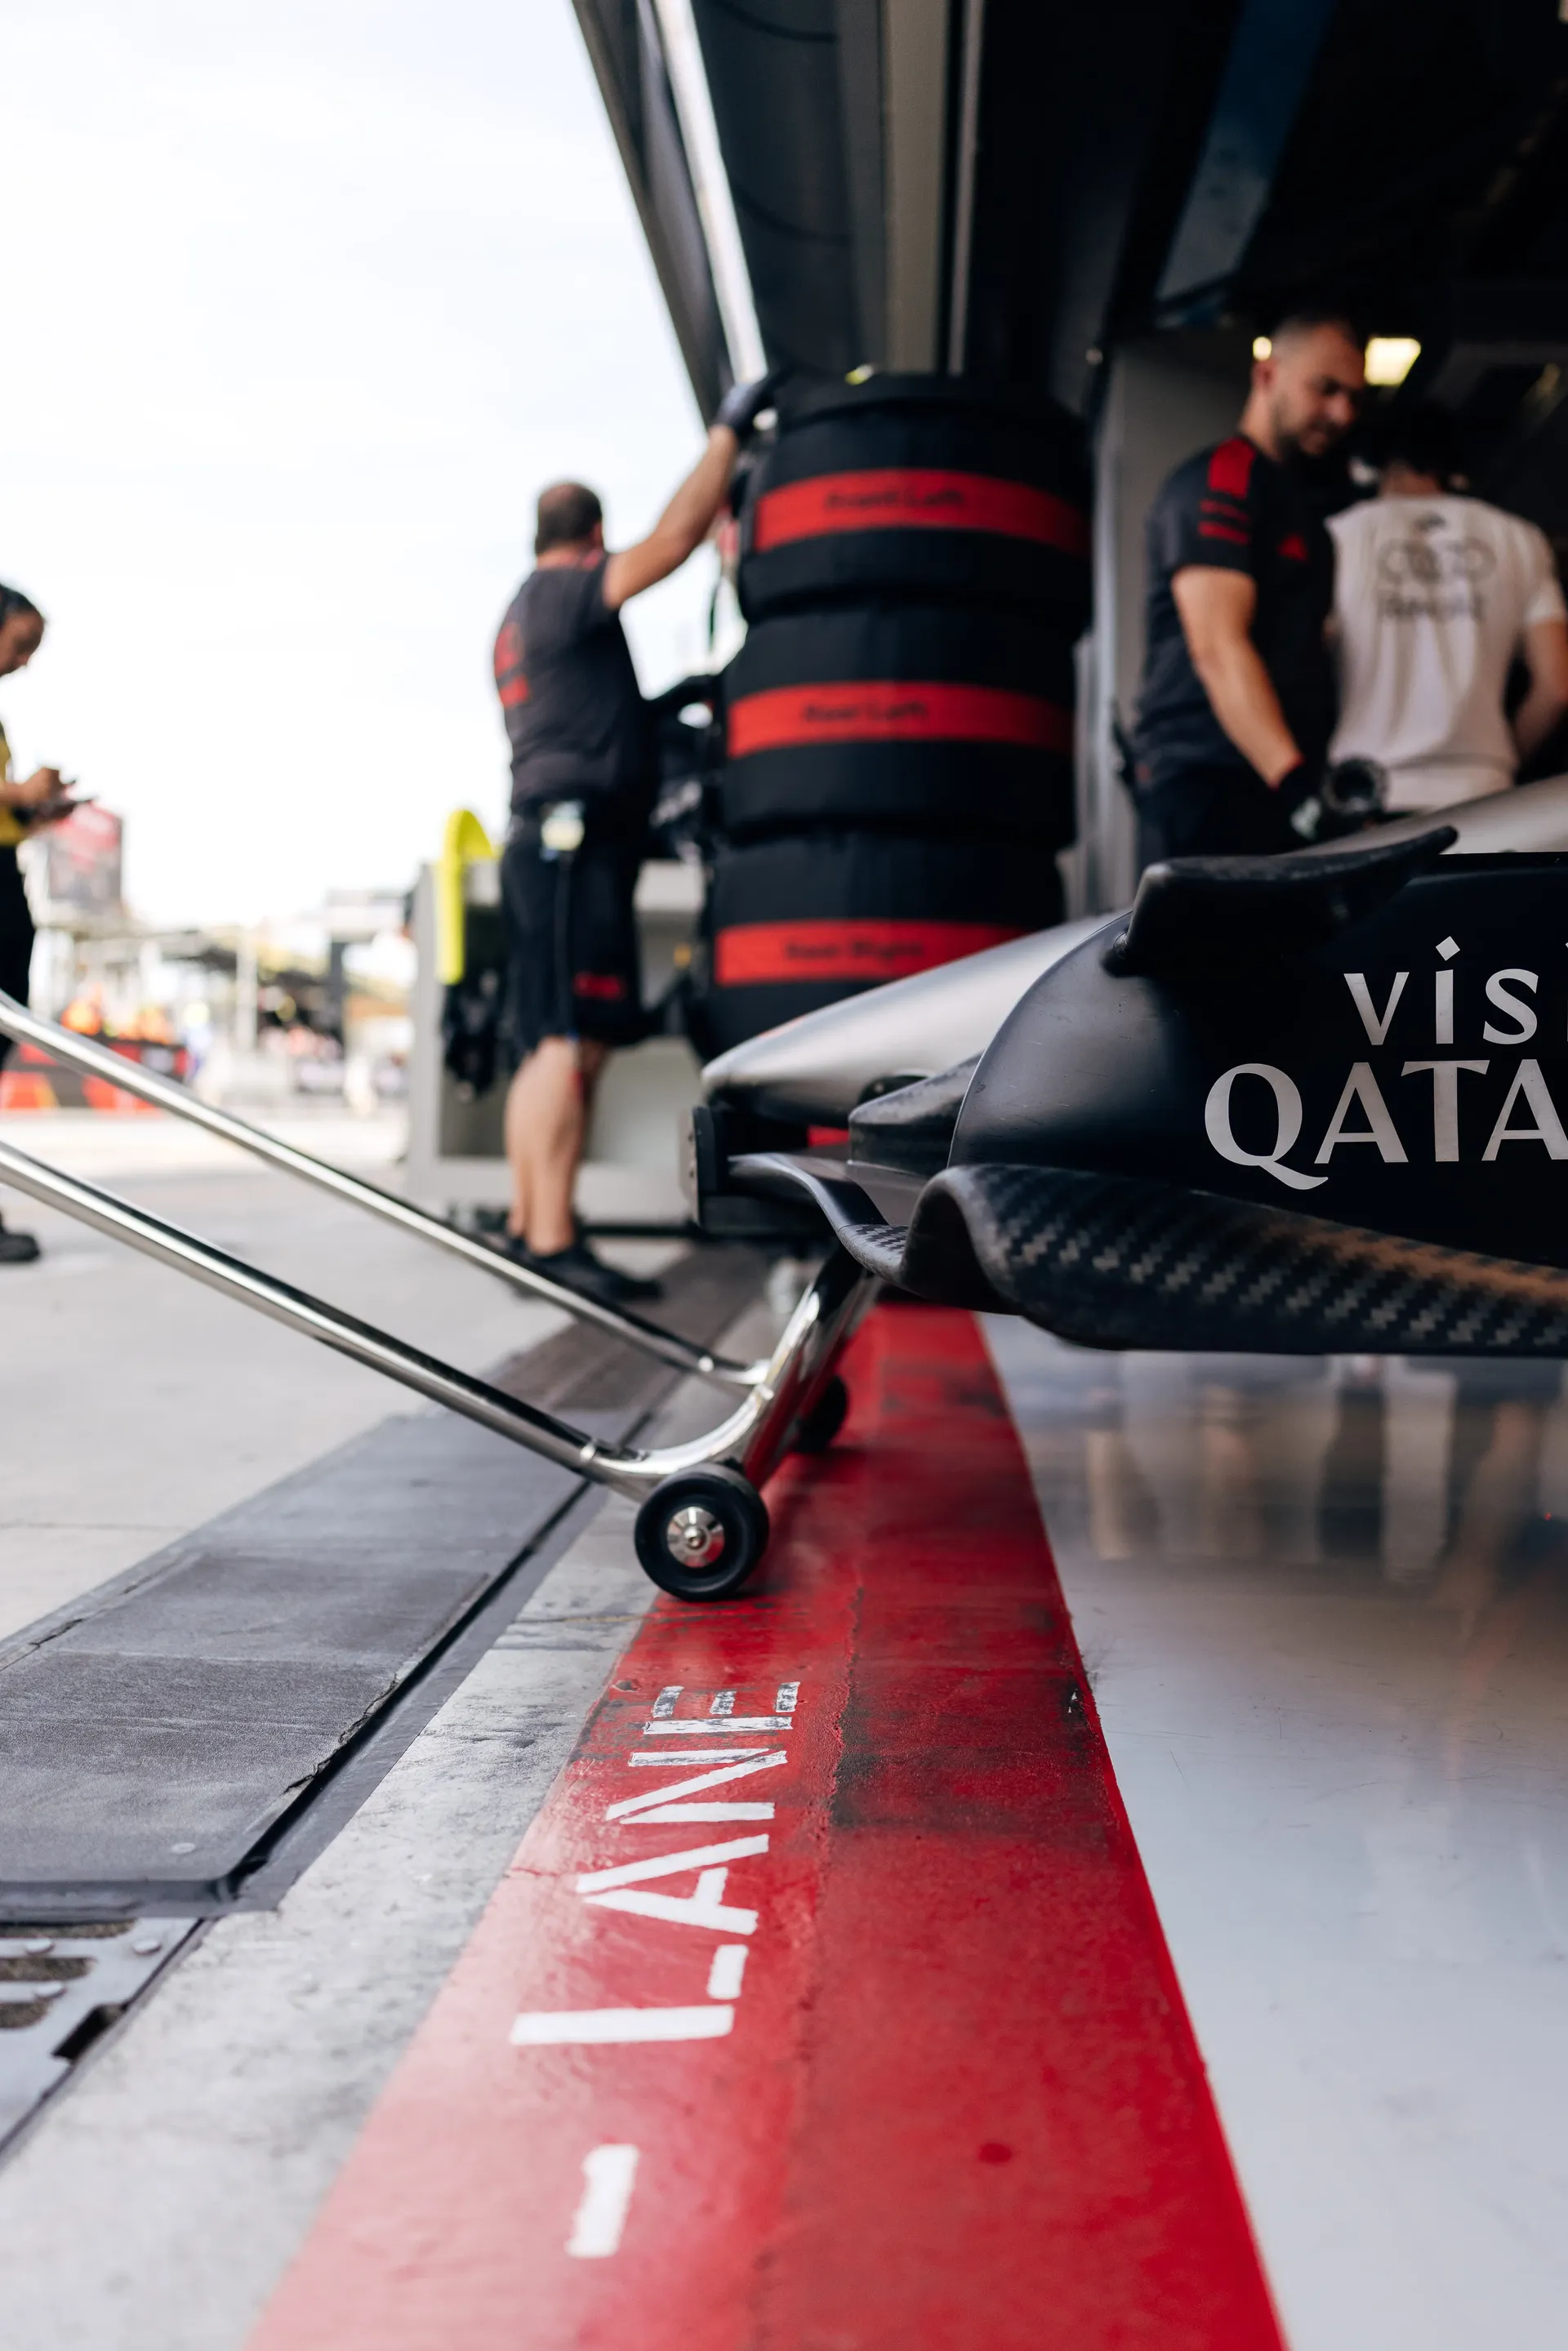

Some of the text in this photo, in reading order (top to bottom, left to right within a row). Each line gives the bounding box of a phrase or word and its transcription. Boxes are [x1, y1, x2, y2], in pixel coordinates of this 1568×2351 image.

[1343, 936, 1568, 1045] vis
[1205, 1059, 1568, 1190] QATA
[510, 1681, 801, 2046] LANE
